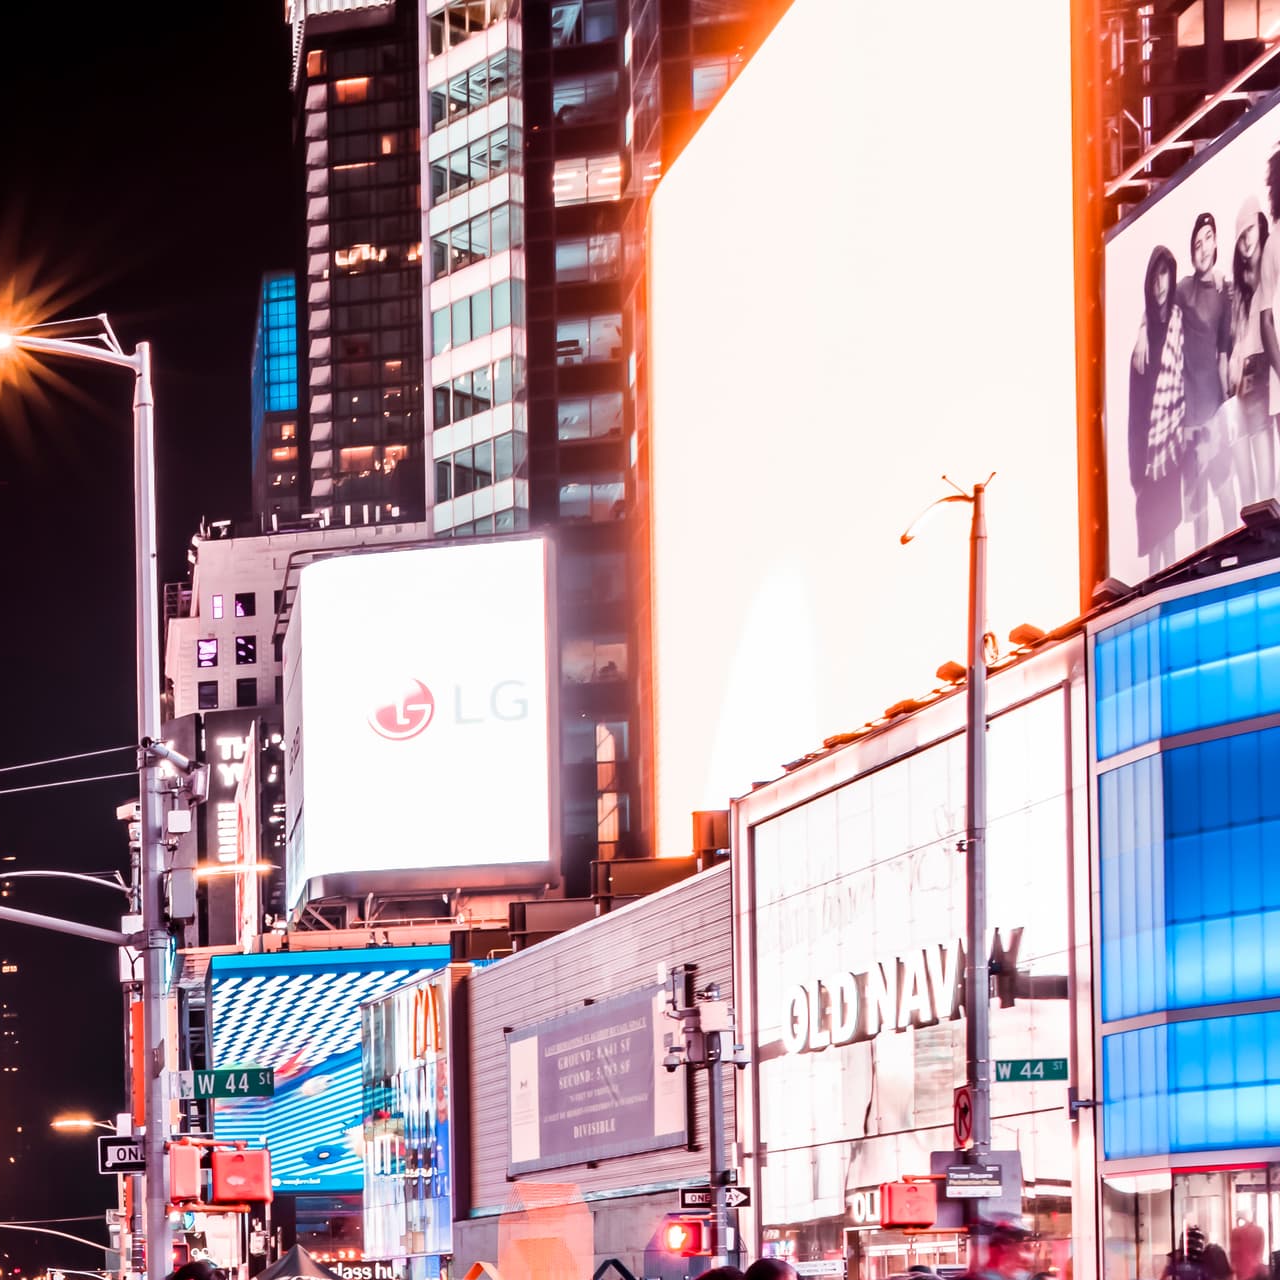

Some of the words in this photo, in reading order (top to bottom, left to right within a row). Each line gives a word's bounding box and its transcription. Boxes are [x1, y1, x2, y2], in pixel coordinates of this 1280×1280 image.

[453, 679, 530, 726] LG
[783, 972, 861, 1053] OLD
[559, 1069, 594, 1090] SECOND:
[997, 1062, 1012, 1080] W
[1020, 1062, 1045, 1079] 44
[197, 1074, 216, 1095] W
[225, 1073, 250, 1094] 44
[573, 1117, 616, 1139] DIVISIBLE
[690, 1193, 713, 1203] ONE
[724, 1192, 740, 1202] AY
[853, 1195, 881, 1222] OL
[329, 1262, 373, 1280] lass
[375, 1262, 397, 1280] hu
